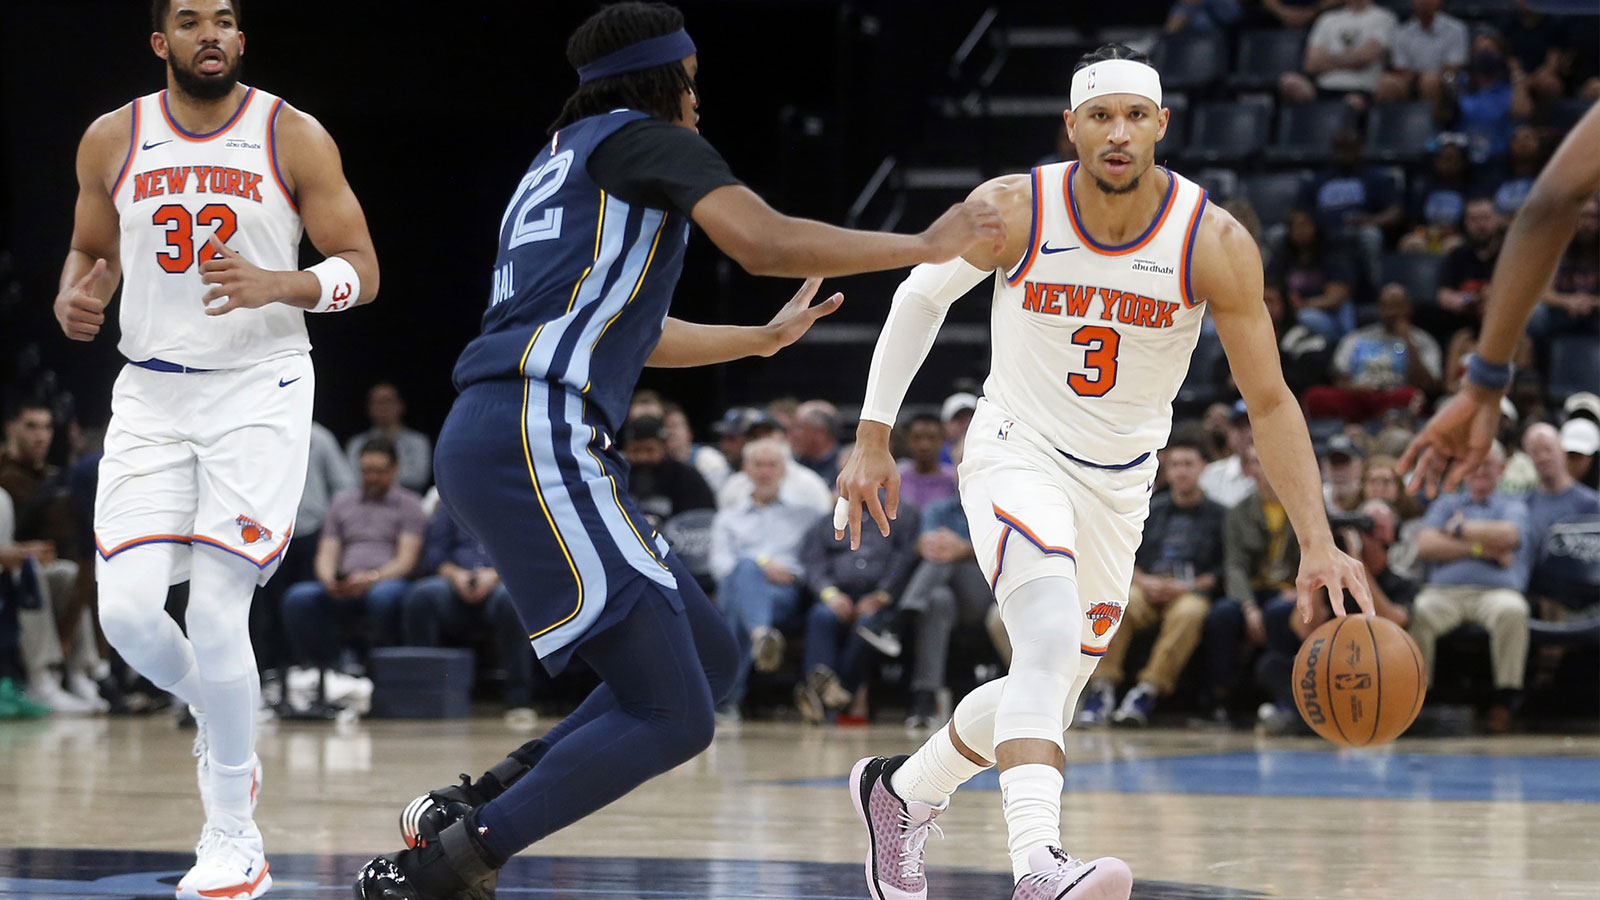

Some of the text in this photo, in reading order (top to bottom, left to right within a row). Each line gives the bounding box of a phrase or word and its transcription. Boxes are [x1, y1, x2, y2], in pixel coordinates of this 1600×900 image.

[133, 165, 263, 203] NEW YORK
[152, 203, 239, 274] 32
[492, 260, 515, 308] BAL
[1132, 262, 1174, 275] abu dhabi
[1022, 280, 1181, 329] NEW YORK
[1067, 324, 1121, 398] 3
